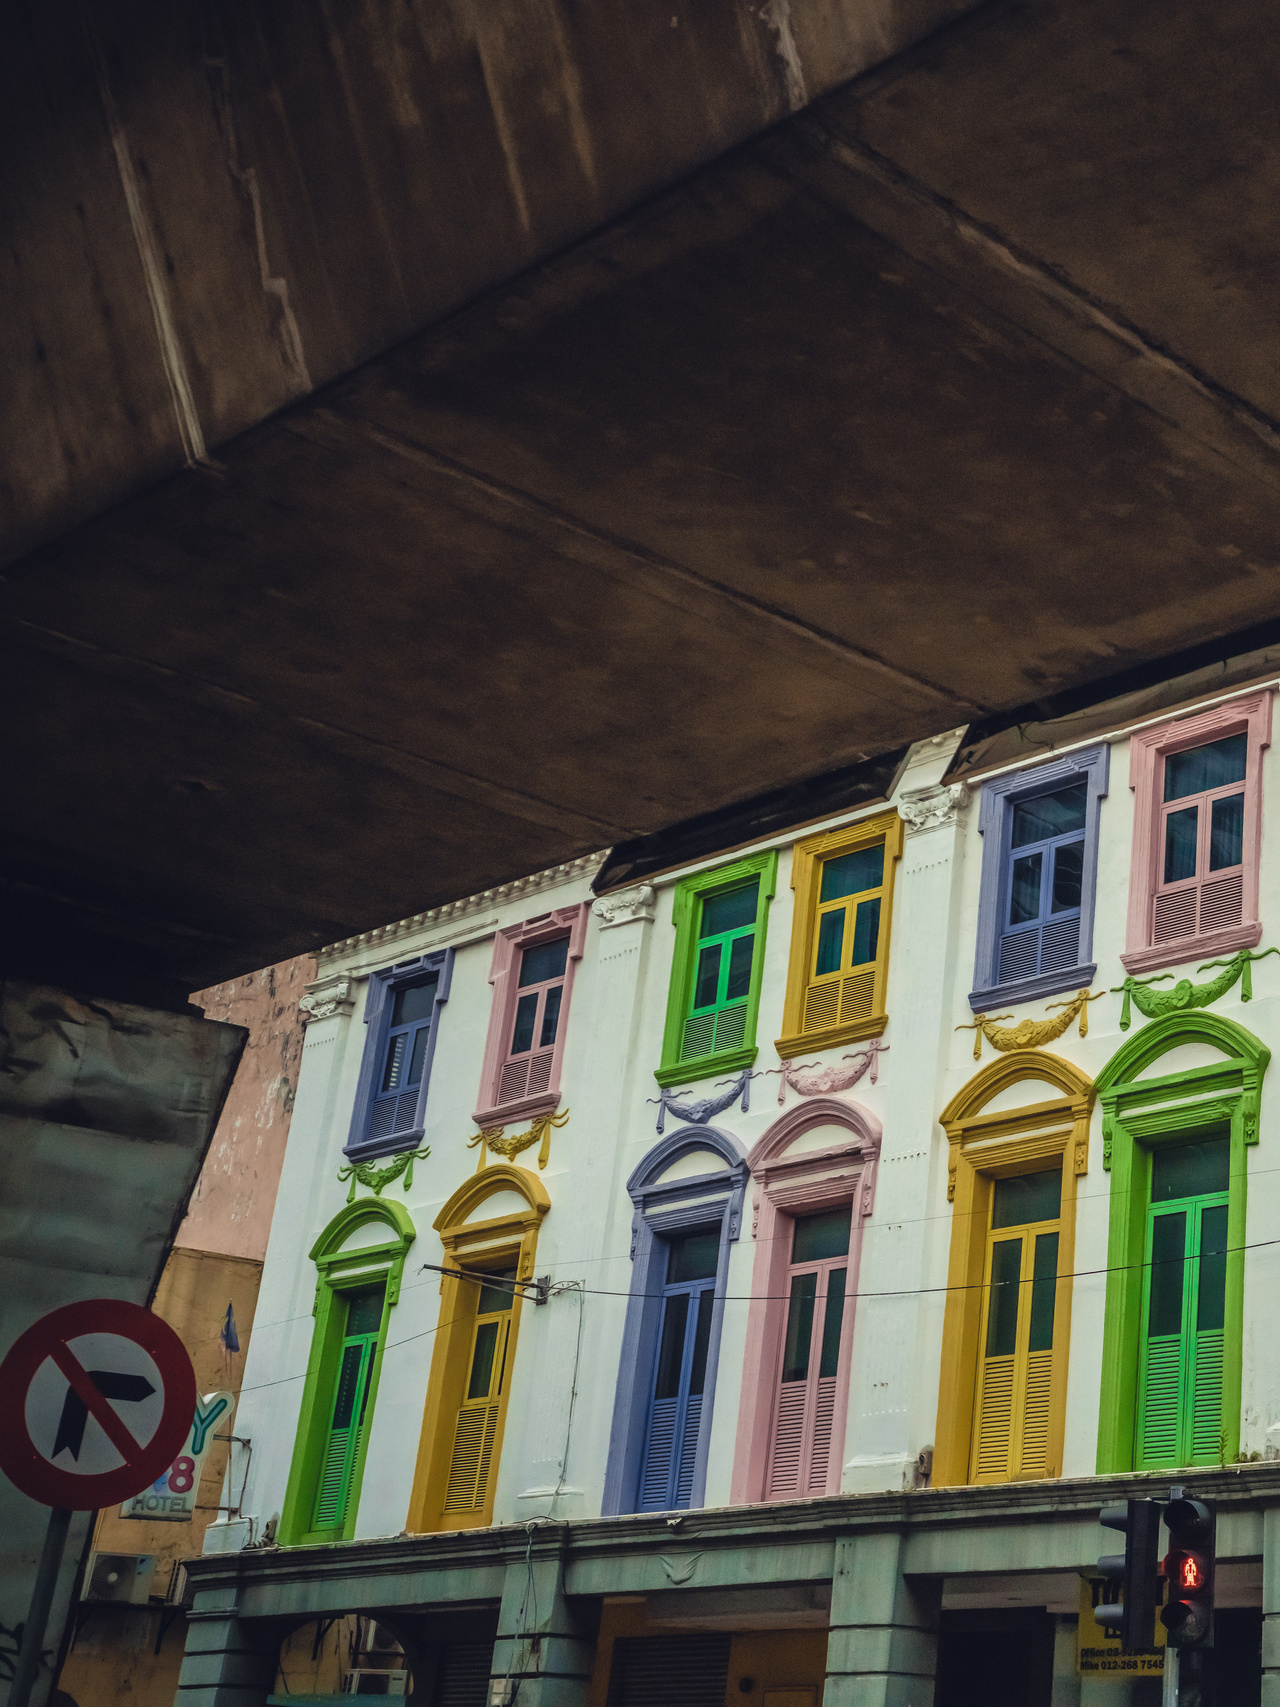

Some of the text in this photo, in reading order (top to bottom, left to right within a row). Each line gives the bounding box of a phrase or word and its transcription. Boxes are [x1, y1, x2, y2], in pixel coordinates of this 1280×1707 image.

[131, 1494, 192, 1513] HOTEL
[1081, 1647, 1105, 1658] Office
[1080, 1659, 1165, 1670] Mike 012-268 7545
